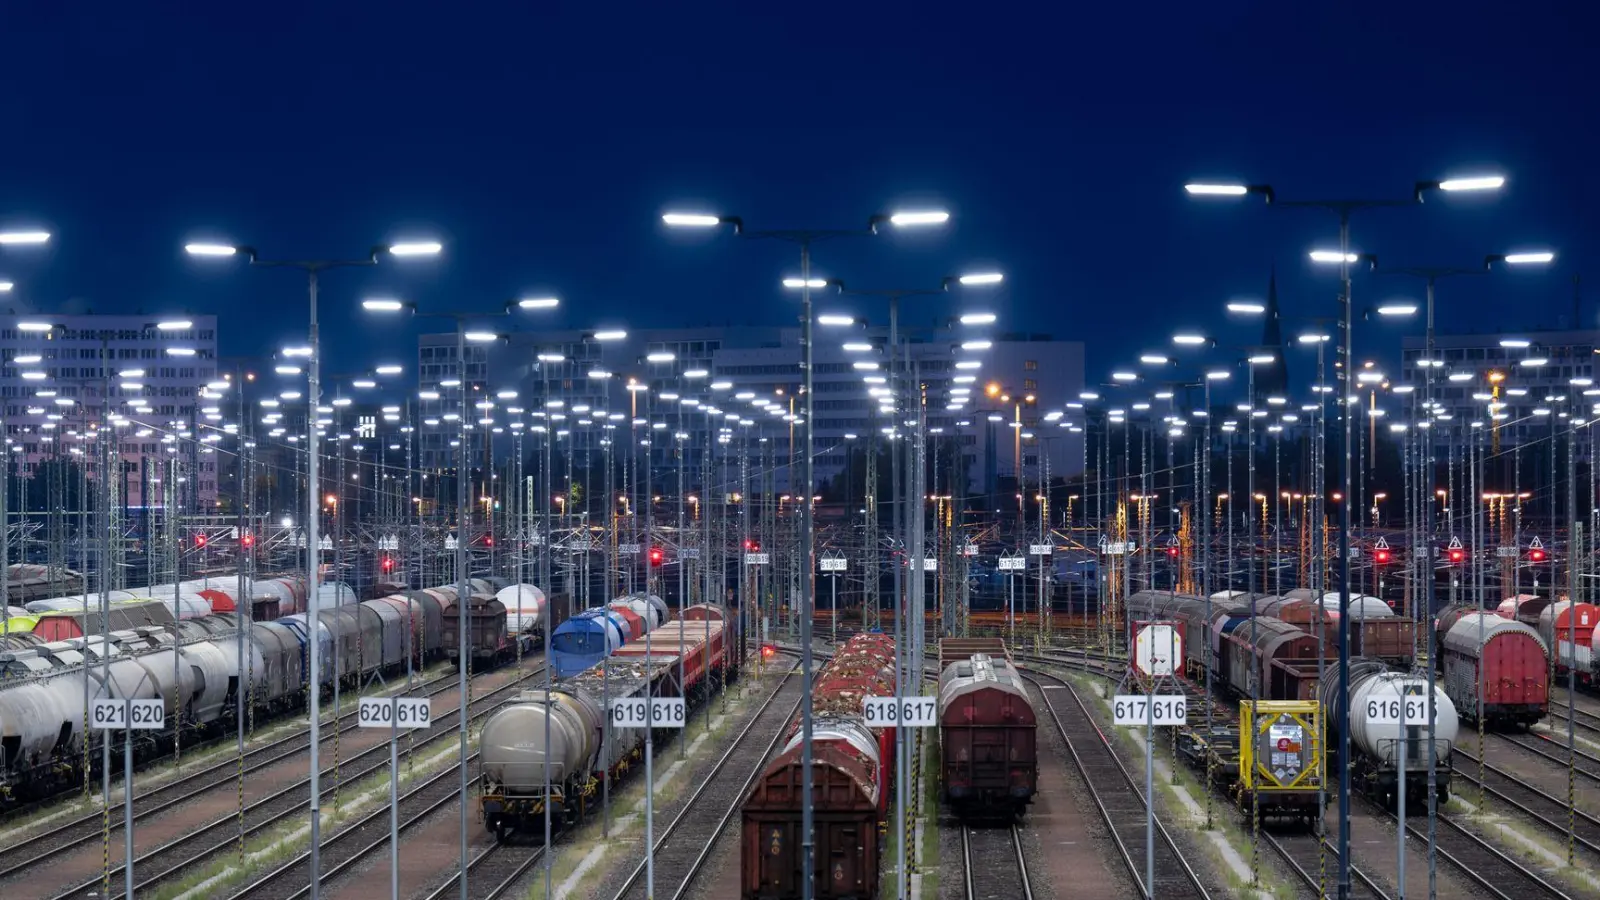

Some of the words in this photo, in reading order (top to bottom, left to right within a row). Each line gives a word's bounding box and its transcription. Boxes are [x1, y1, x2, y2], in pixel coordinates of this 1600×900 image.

[821, 560, 833, 568] 619
[834, 560, 846, 568] 618
[925, 560, 936, 568] 617
[1000, 559, 1011, 567] 617
[1013, 559, 1024, 567] 616
[95, 705, 125, 722] 621
[132, 705, 163, 722] 620
[360, 704, 392, 721] 620
[398, 704, 429, 721] 619
[615, 704, 646, 721] 619
[652, 704, 684, 721] 618
[866, 703, 897, 721] 618
[903, 703, 935, 720] 617
[1115, 701, 1147, 719] 617
[1153, 701, 1185, 719] 616
[1367, 701, 1399, 718] 616
